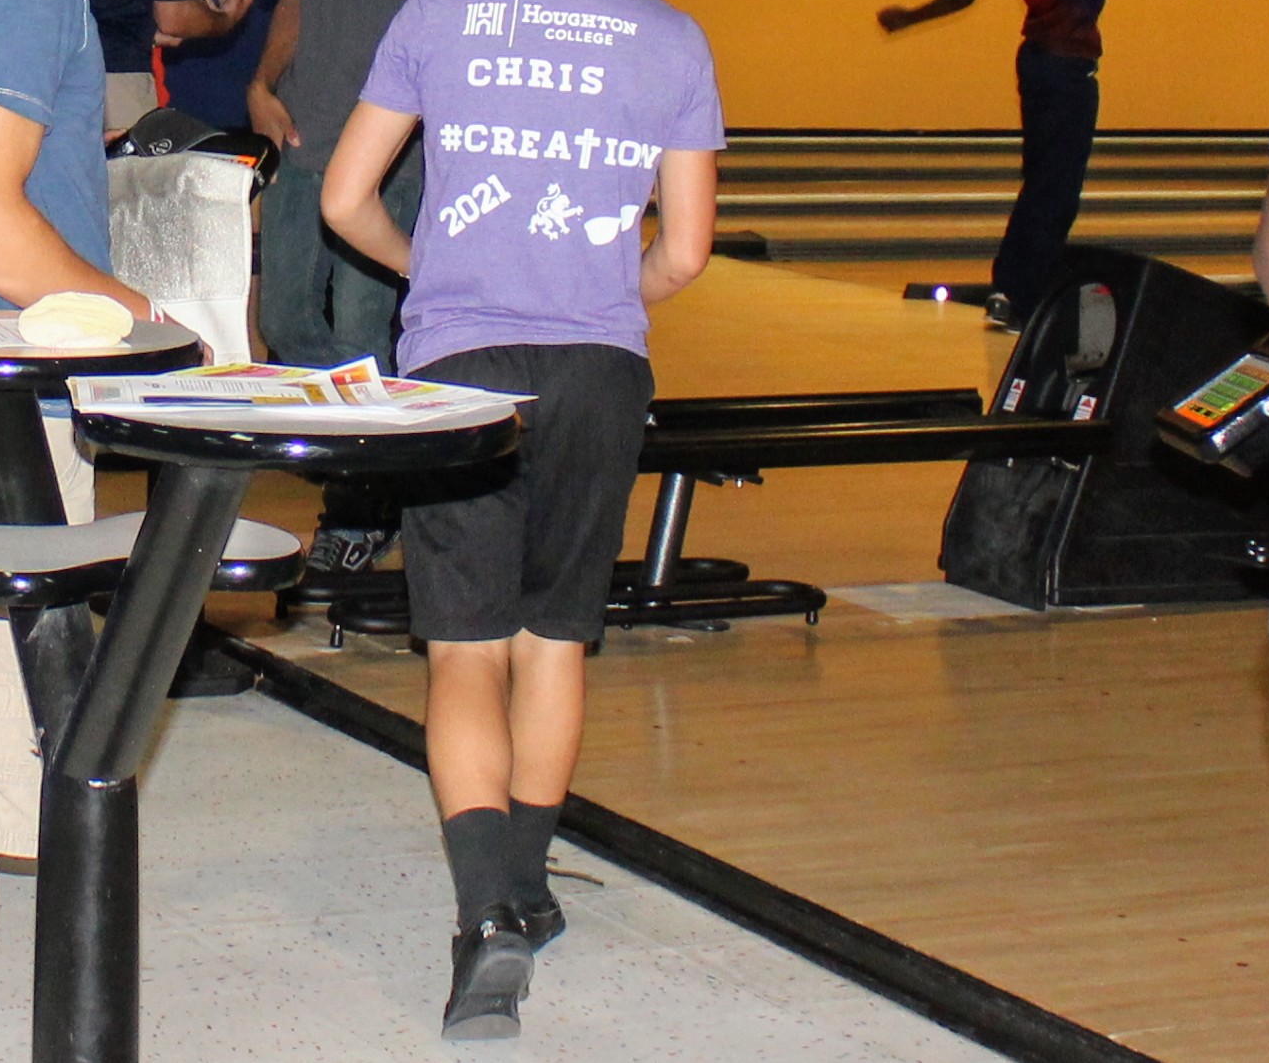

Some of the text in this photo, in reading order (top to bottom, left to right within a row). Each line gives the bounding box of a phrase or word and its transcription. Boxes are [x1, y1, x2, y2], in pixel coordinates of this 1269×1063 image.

[544, 28, 614, 46] COLLEGE
[467, 57, 605, 95] CHRIS
[439, 174, 512, 238] 2021
